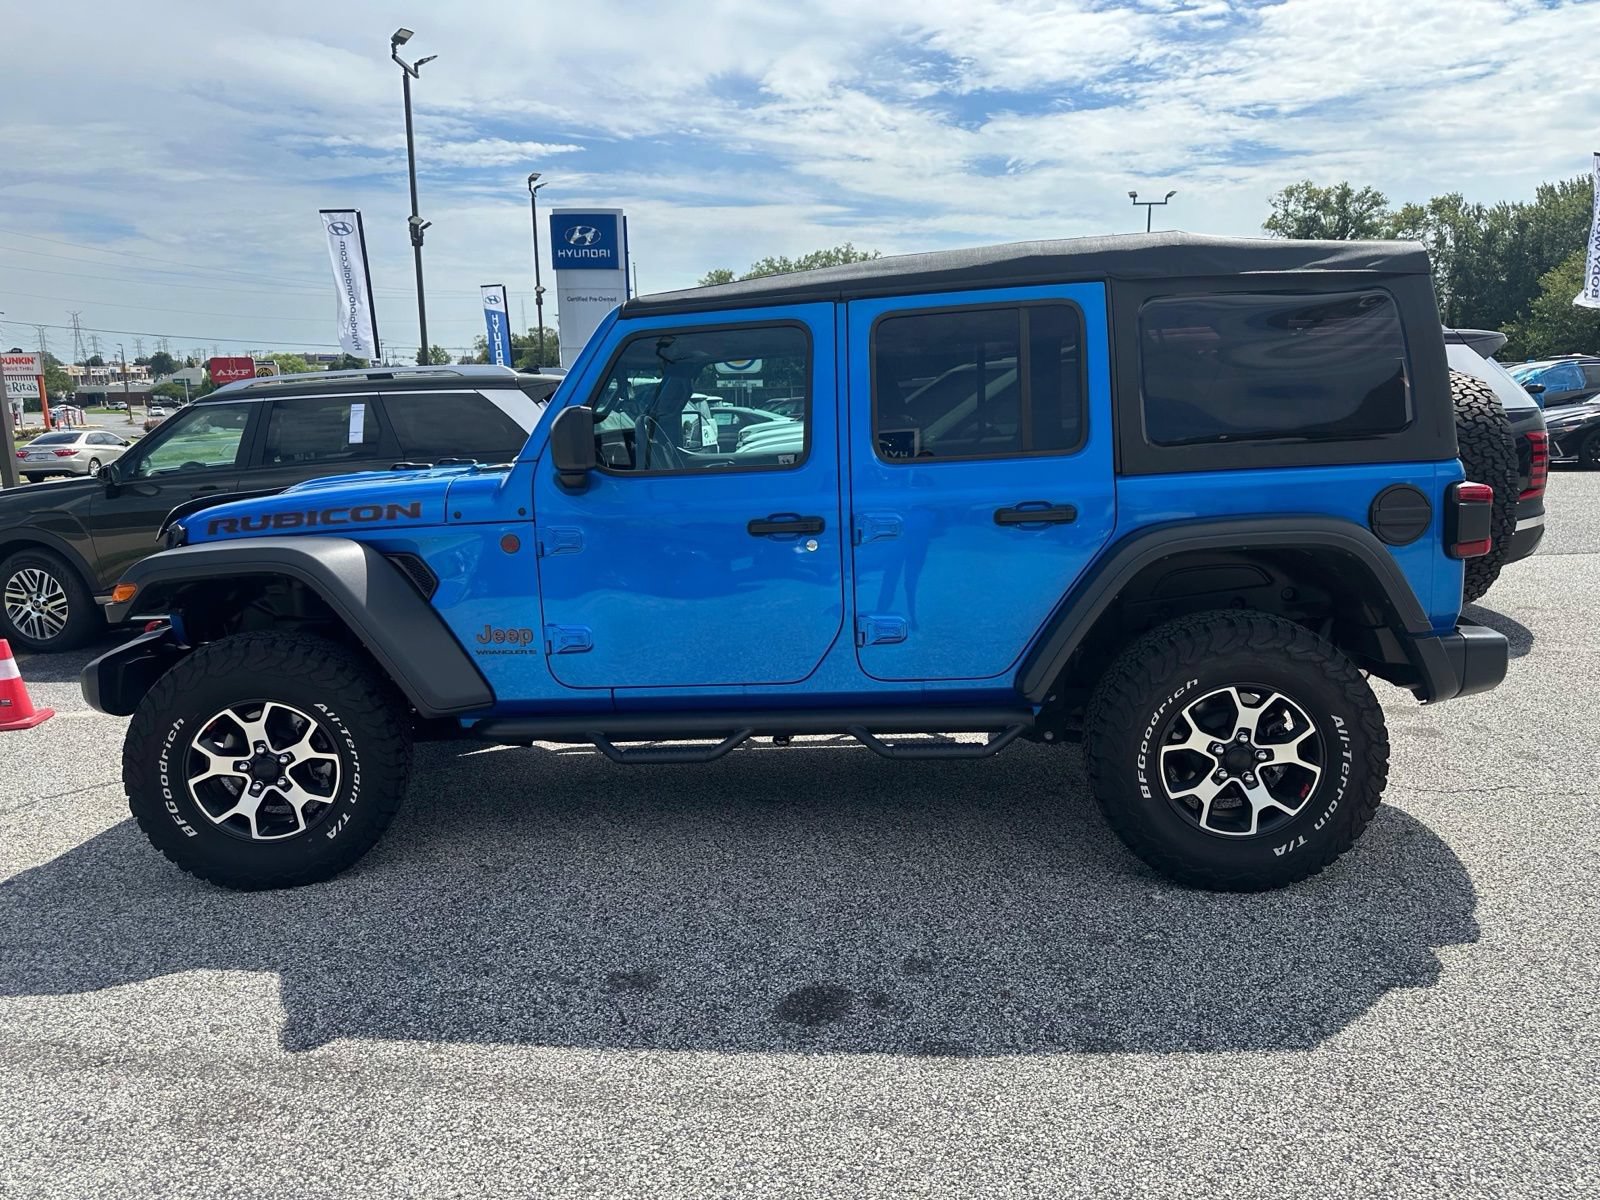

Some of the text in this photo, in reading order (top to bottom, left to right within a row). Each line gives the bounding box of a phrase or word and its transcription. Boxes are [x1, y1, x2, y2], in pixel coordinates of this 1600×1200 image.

[558, 249, 611, 258] HYUNDAI
[12, 382, 38, 393] Rita's
[207, 502, 421, 535] RUBICON
[477, 624, 534, 647] Jeep
[313, 703, 361, 840] All-Terrain T/A
[1138, 678, 1198, 799] BFGoodrich
[158, 717, 198, 838] BFGoodrich
[1273, 714, 1352, 857] All-Terrain T/A
